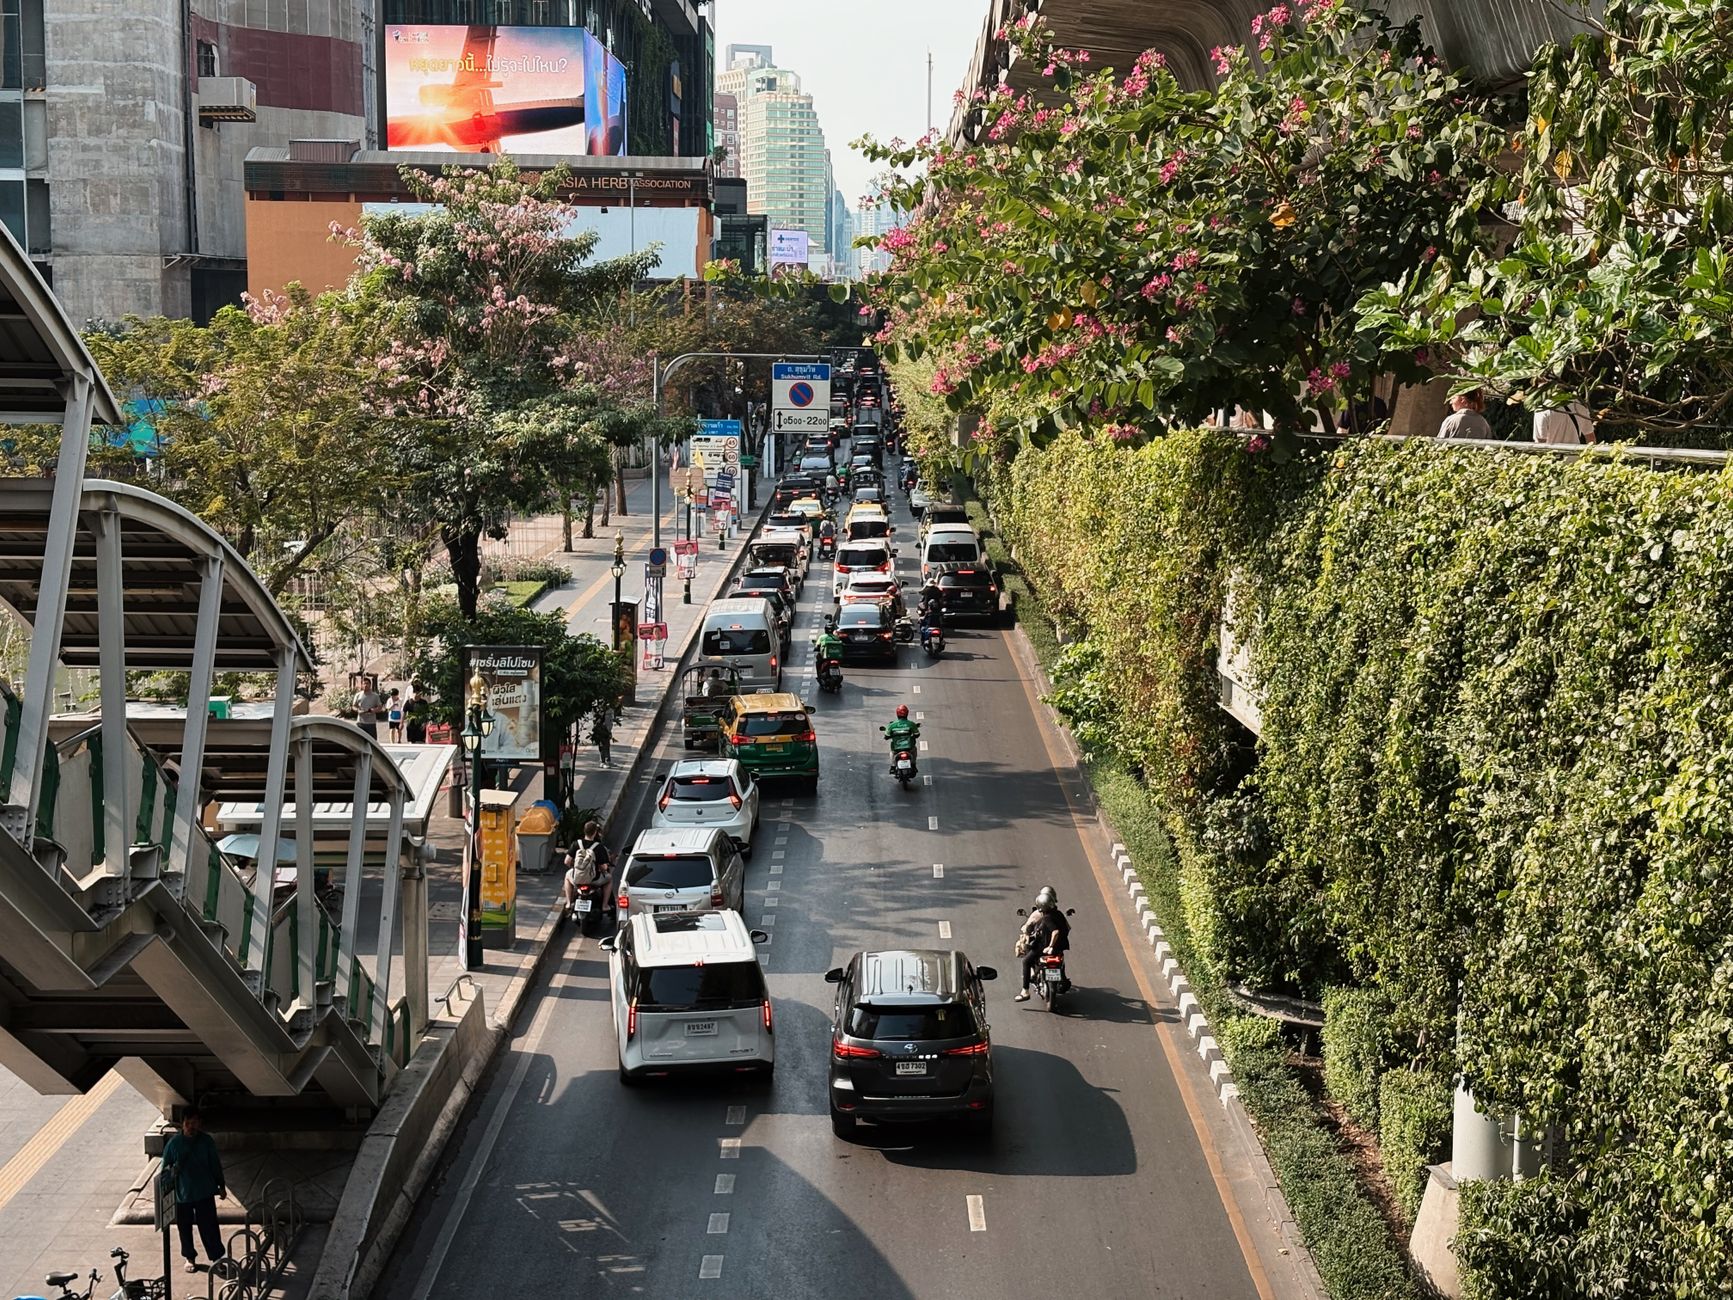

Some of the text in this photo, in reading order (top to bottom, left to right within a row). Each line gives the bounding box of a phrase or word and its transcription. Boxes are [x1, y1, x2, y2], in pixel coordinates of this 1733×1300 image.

[558, 177, 691, 189] ASIA HERB ASSOCIATION
[453, 773, 462, 785] 7
